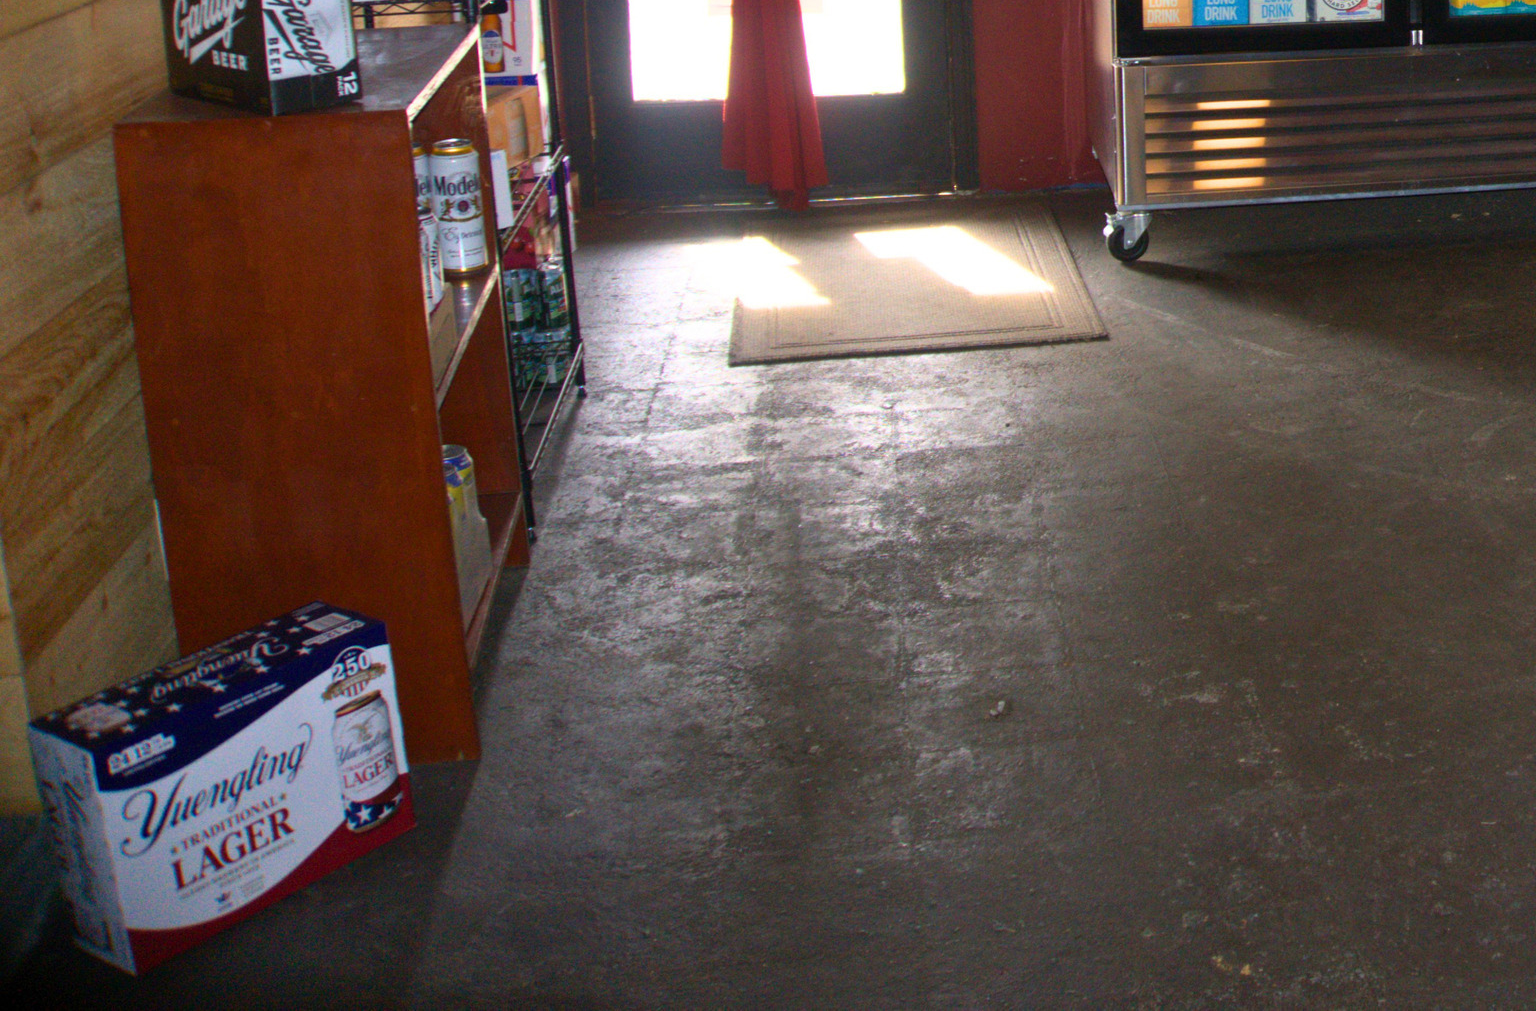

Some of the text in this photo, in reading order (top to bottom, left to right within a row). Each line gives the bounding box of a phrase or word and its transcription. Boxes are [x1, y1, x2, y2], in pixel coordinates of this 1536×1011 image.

[1147, 9, 1180, 24] DRINK
[1204, 6, 1238, 21] DRINK
[1261, 4, 1294, 18] DRINK
[211, 49, 249, 71] BEER
[267, 37, 283, 75] BEER
[336, 75, 345, 97] PACK
[342, 71, 359, 95] 12
[434, 173, 480, 196] Model
[331, 651, 372, 683] 250
[343, 757, 395, 789] LAGER
[121, 722, 313, 858] Yuengling
[182, 797, 278, 851] TRADITIONAL
[171, 808, 295, 890] LAGER
